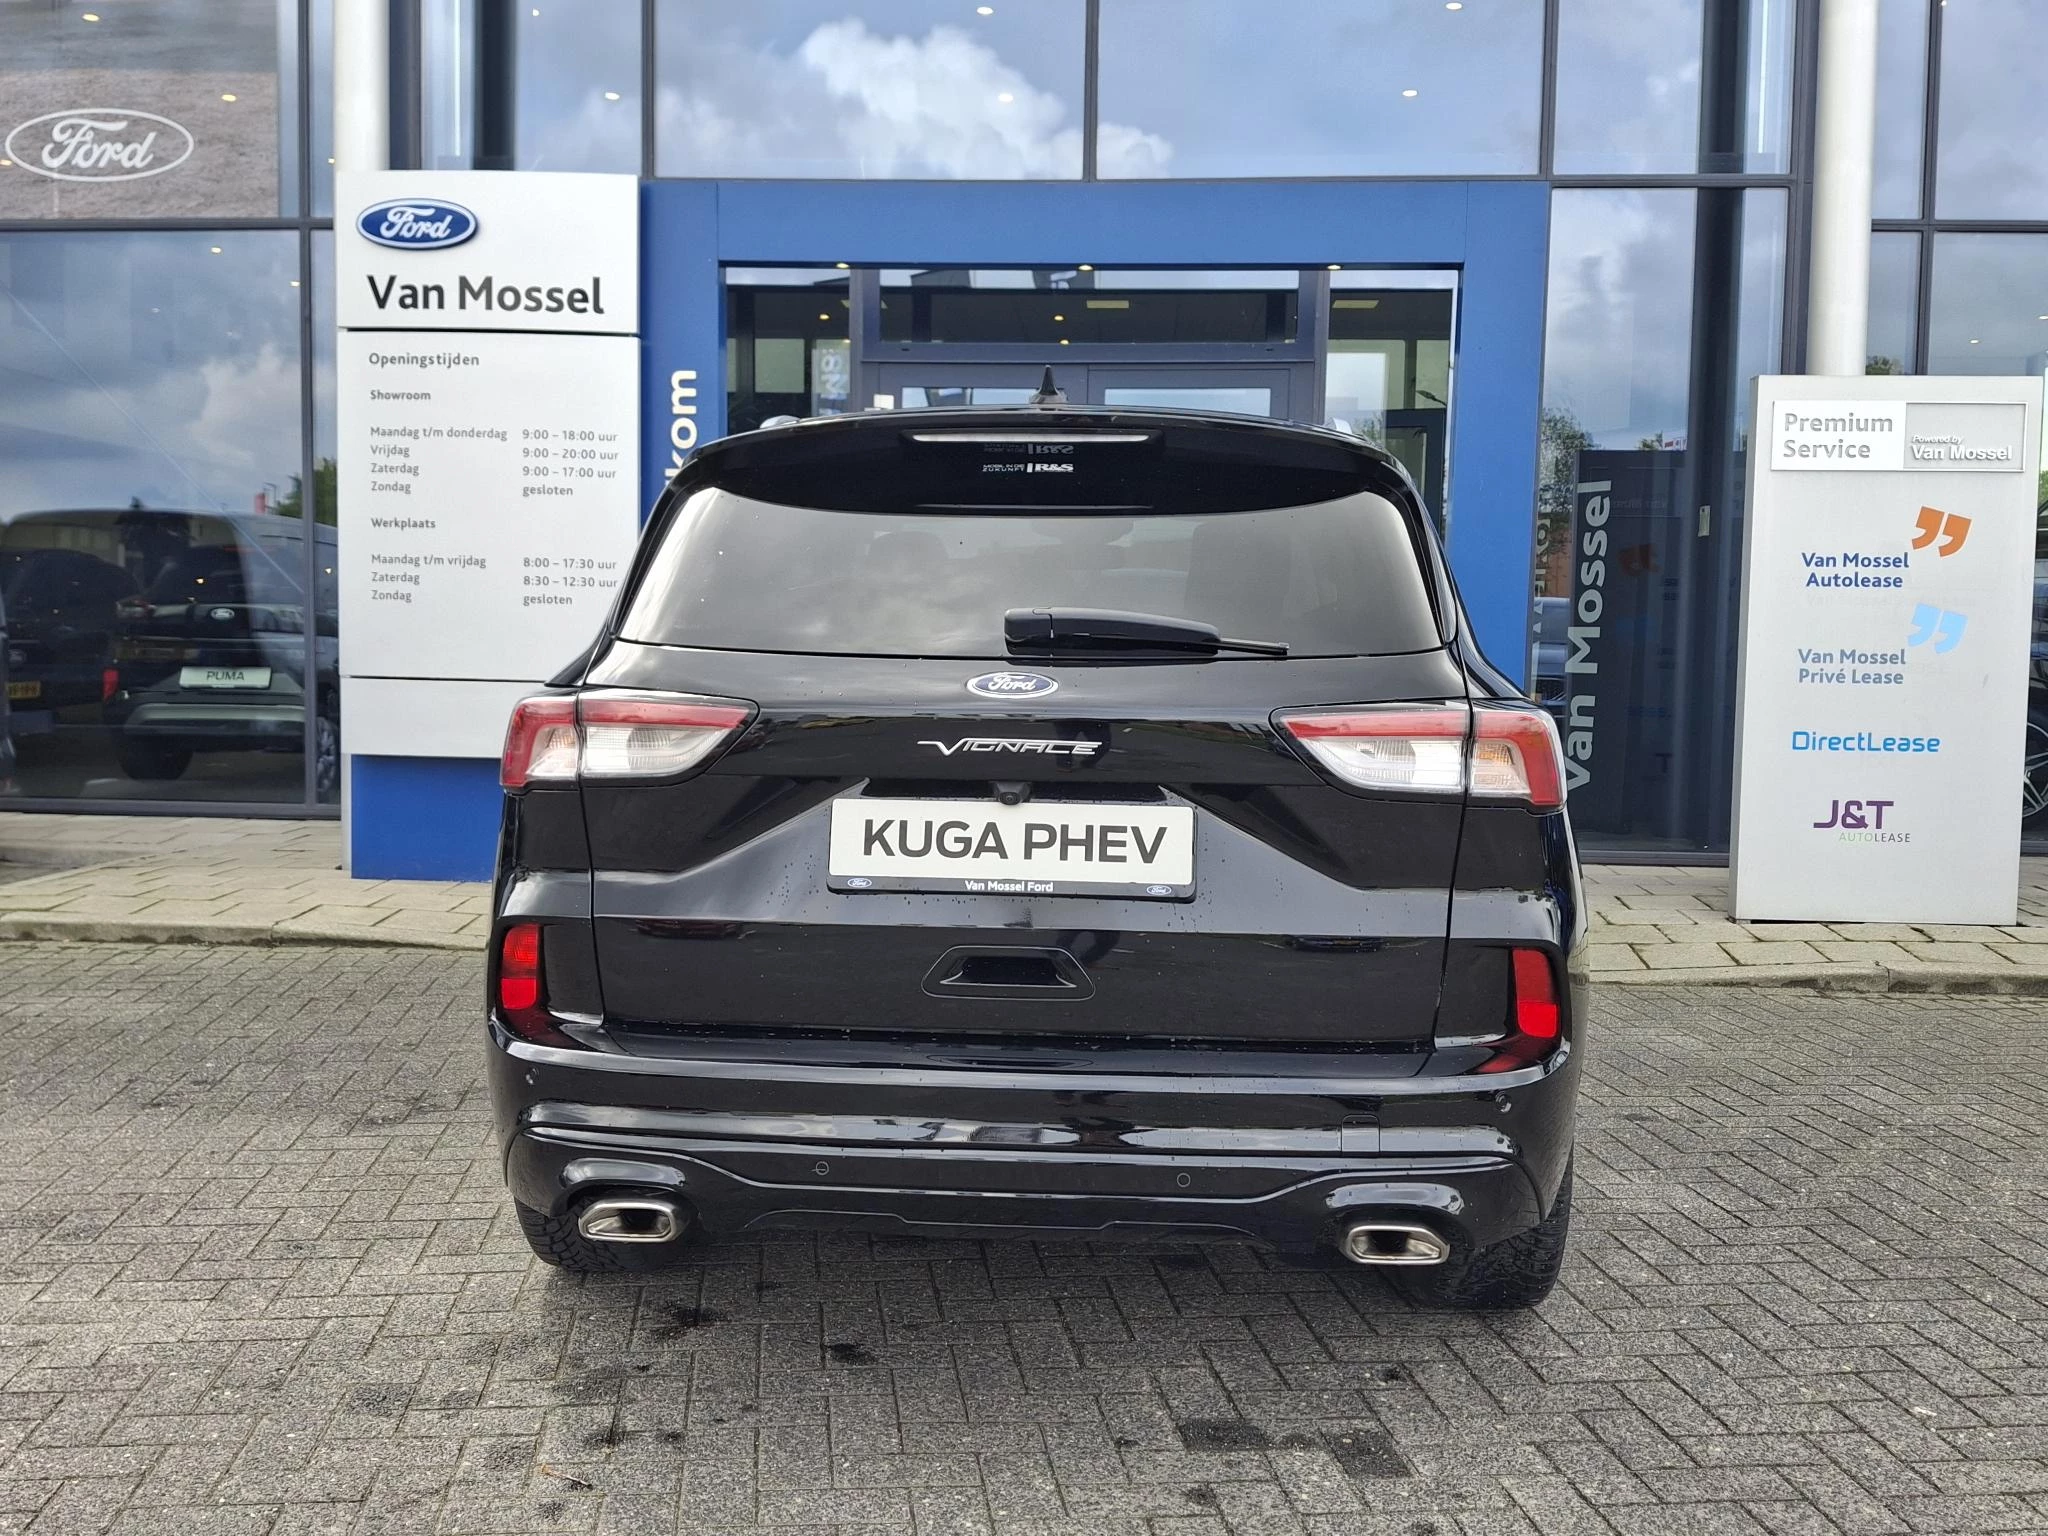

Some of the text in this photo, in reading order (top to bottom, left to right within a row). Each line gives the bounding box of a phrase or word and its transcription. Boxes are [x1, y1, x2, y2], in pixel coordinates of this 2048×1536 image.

[41, 118, 157, 168] Ford
[379, 206, 453, 239] Ford
[367, 275, 604, 314] Van Mossel
[368, 352, 480, 369] Openingstijden
[370, 389, 432, 401] Showroom
[1785, 412, 1892, 432] Premium
[370, 426, 420, 440] Maandag
[422, 426, 444, 438] t/m
[446, 426, 508, 442] donderdag
[522, 428, 549, 440] 9:00
[562, 430, 595, 442] 18:00
[598, 433, 618, 442] uur
[1911, 434, 1964, 446] Powered by
[370, 444, 411, 459] Vrijdag
[522, 447, 549, 459] 9:00
[561, 448, 597, 460] 20:00
[599, 452, 619, 461] uur
[1784, 439, 1870, 458] Service
[1912, 444, 2013, 462] Van Mossel
[370, 462, 420, 477] Zaterdag
[522, 465, 550, 477] 9:00
[562, 466, 594, 478] 17:00
[597, 470, 617, 479] uur
[1035, 463, 1073, 472] R&S
[371, 480, 574, 498] Zondag gesloten
[370, 517, 436, 531] Werkplaats
[371, 553, 421, 568] Maandag
[423, 554, 445, 566] t/m
[447, 554, 487, 570] vrijdag
[523, 556, 550, 568] 8:00
[562, 558, 595, 569] 17:30
[597, 561, 617, 570] uur
[1801, 551, 1910, 569] Van Mossel
[371, 571, 421, 586] Zaterdag
[523, 575, 550, 586] 8:30
[562, 576, 596, 588] 12:30
[598, 579, 618, 588] uur
[1805, 571, 1904, 588] Autolease
[371, 589, 573, 607] Zondag gesloten
[1565, 480, 1612, 790] Van Mossel
[1797, 648, 1907, 665] Van Mossel
[206, 671, 245, 682] PUMA
[1798, 667, 1904, 685] Privé Lease
[1792, 731, 1941, 753] DirectLease
[1814, 800, 1894, 829] J&T
[864, 819, 1167, 863] KUGA PHEV
[1839, 832, 1911, 843] AUTOLEASE
[964, 879, 1054, 893] Van Mossel Ford
